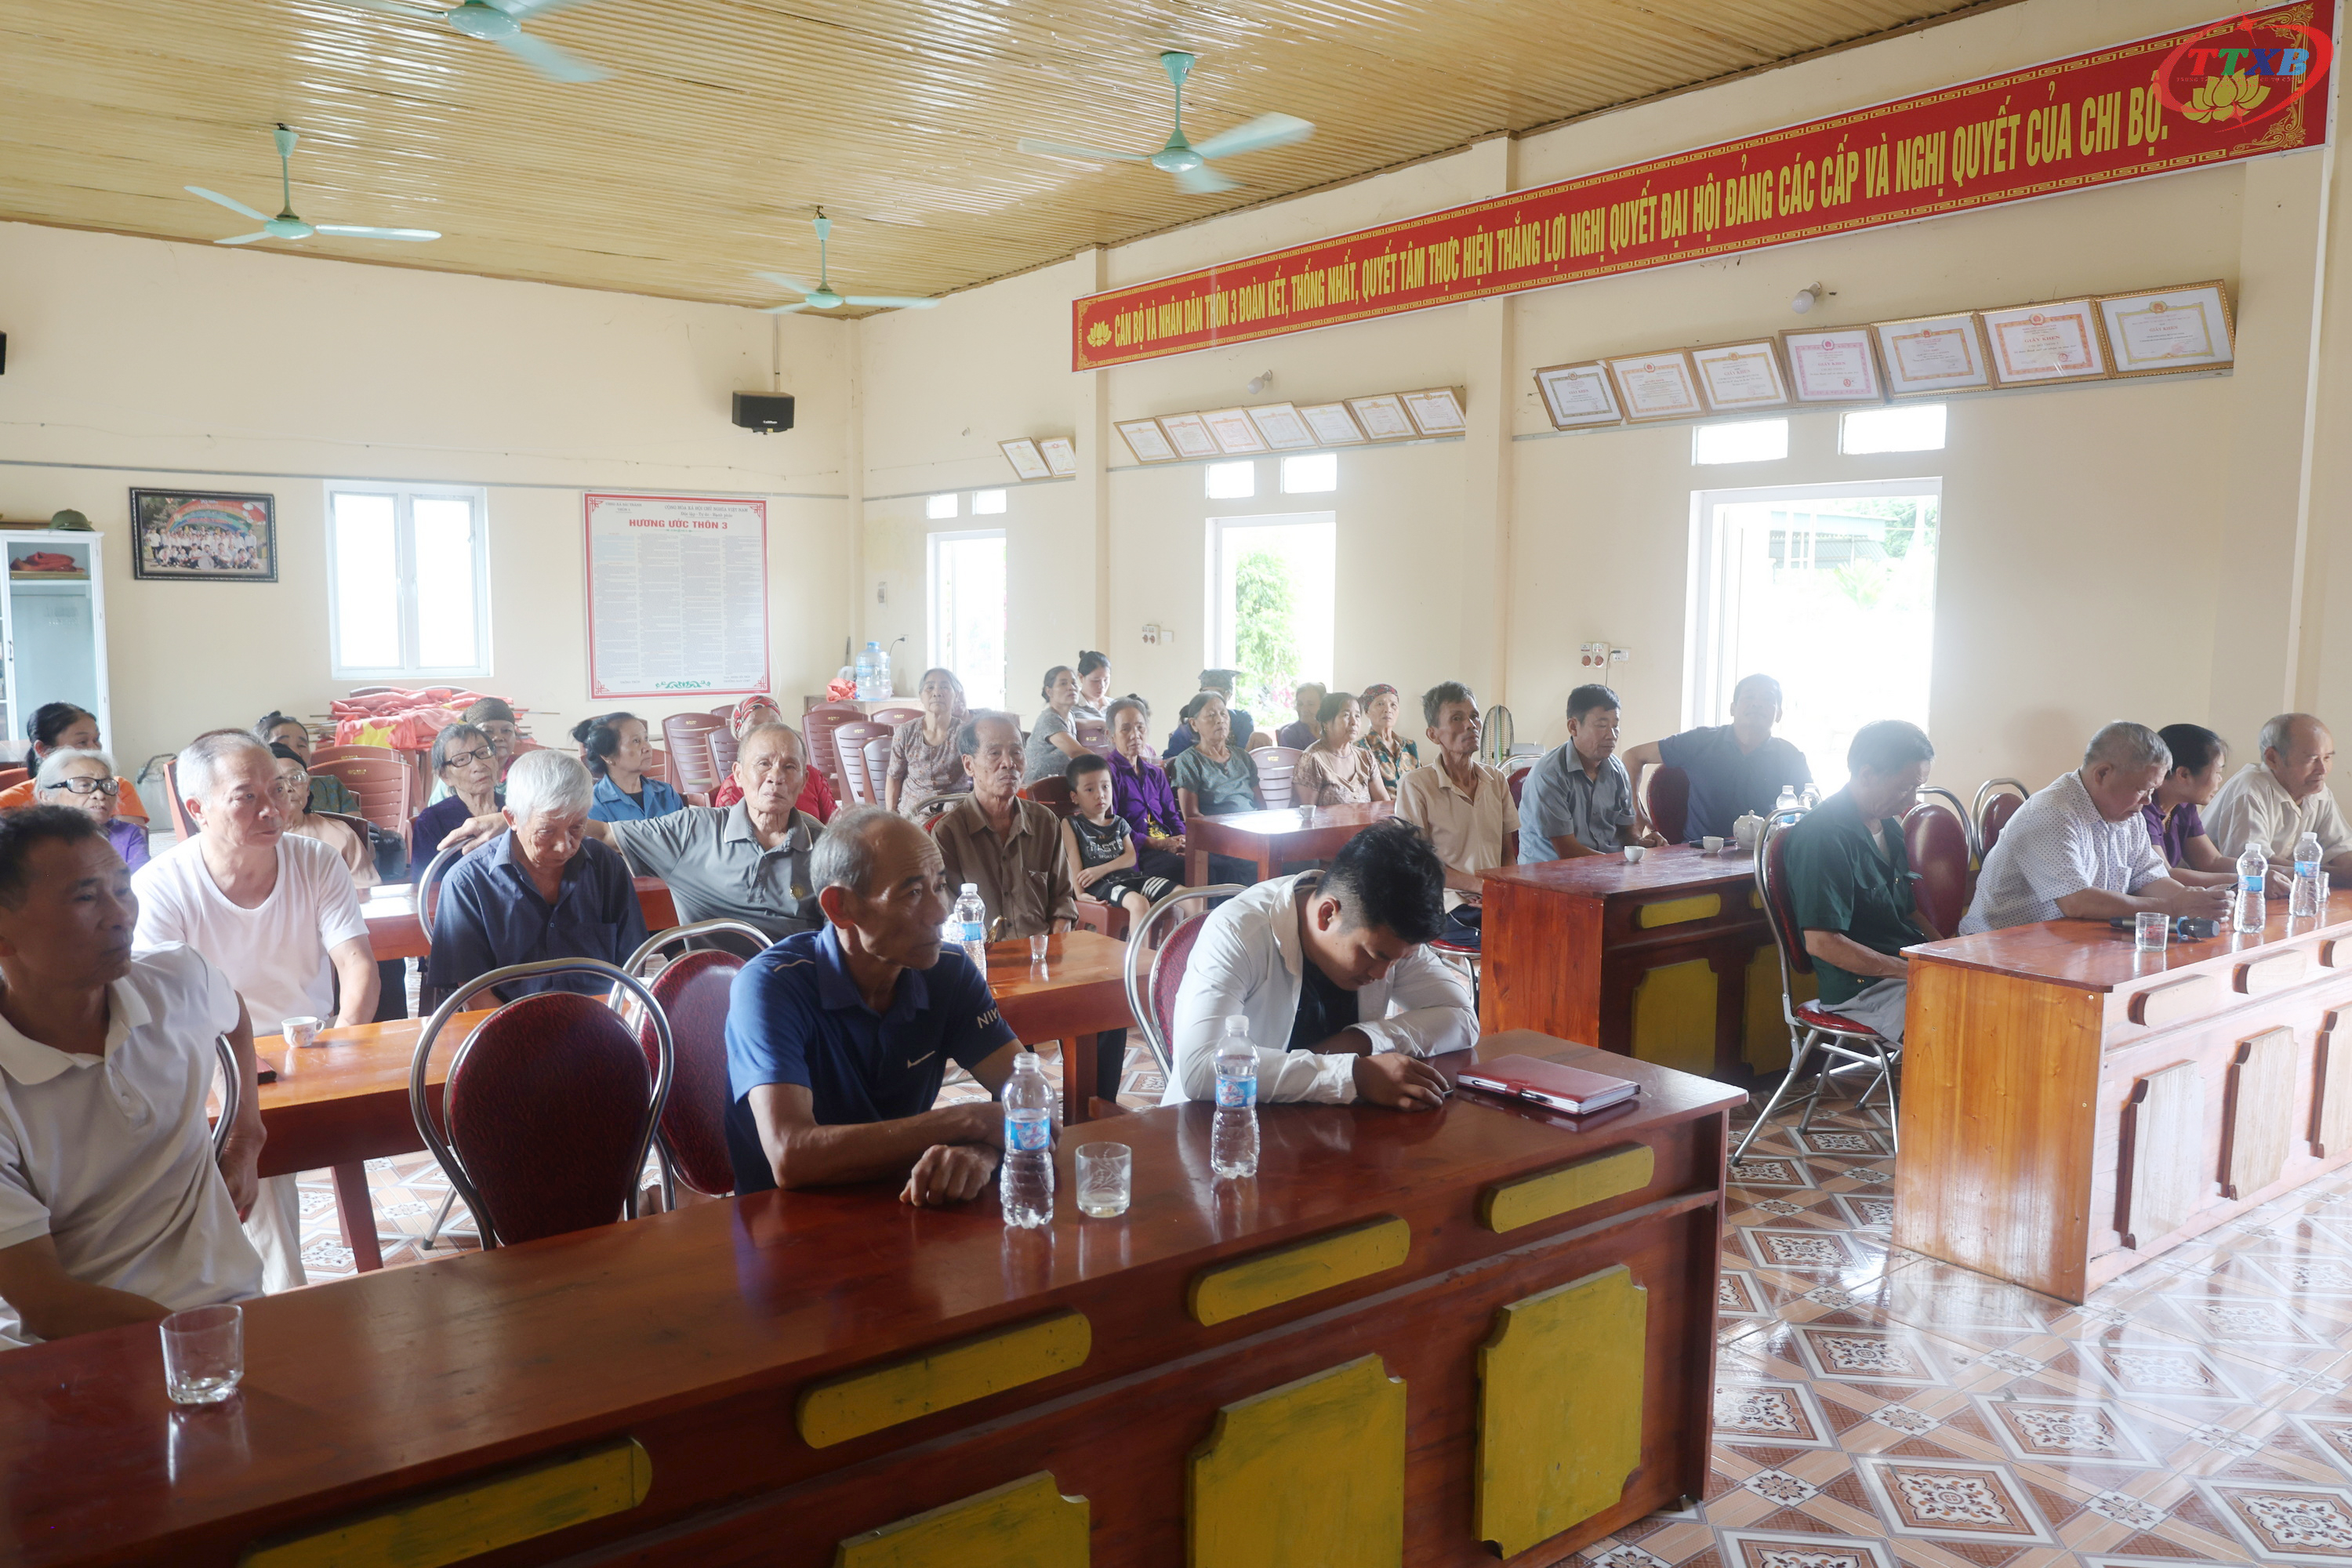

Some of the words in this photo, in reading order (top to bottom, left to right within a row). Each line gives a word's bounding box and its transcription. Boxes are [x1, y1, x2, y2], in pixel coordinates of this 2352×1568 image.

[1115, 307, 1132, 347] CÁN
[1133, 303, 1144, 349] BỘ
[1145, 301, 1157, 341] VÀ
[1159, 296, 1182, 339] NHÂN
[1185, 291, 1203, 332] DÂN
[1205, 285, 1229, 328] THÔN
[1231, 289, 1237, 324] 3
[1239, 278, 1265, 322] ĐOÀN
[1268, 267, 1288, 317] KẾT,
[1291, 260, 1325, 312] THỐNG
[1328, 249, 1359, 304] NHẤT,
[1362, 240, 1397, 301] QUYẾT
[1400, 241, 1425, 290] TÂM
[1428, 237, 1459, 290] THỰC
[1463, 225, 1493, 285] HIỆN
[1497, 211, 1541, 270] THẮNG
[1544, 213, 1566, 270] LỢI
[1570, 207, 1605, 262] NGHỊ
[1610, 180, 1657, 254] QUYẾT
[1661, 189, 1688, 247] ĐẠI
[1693, 172, 1720, 241] HỘI
[1726, 154, 1773, 226] ĐẢNG
[1779, 152, 1815, 216] CÁC
[1821, 134, 1859, 207] CẤP
[1866, 132, 1889, 198] VÀ
[1896, 129, 1947, 196] NGHỊ
[1952, 95, 2020, 187] QUYẾT
[2027, 82, 2071, 166] CỦA
[2081, 92, 2121, 155] CHI
[629, 518, 665, 528] HƯƠNG
[669, 518, 689, 528] ƯỚC
[692, 520, 719, 529] THÔN
